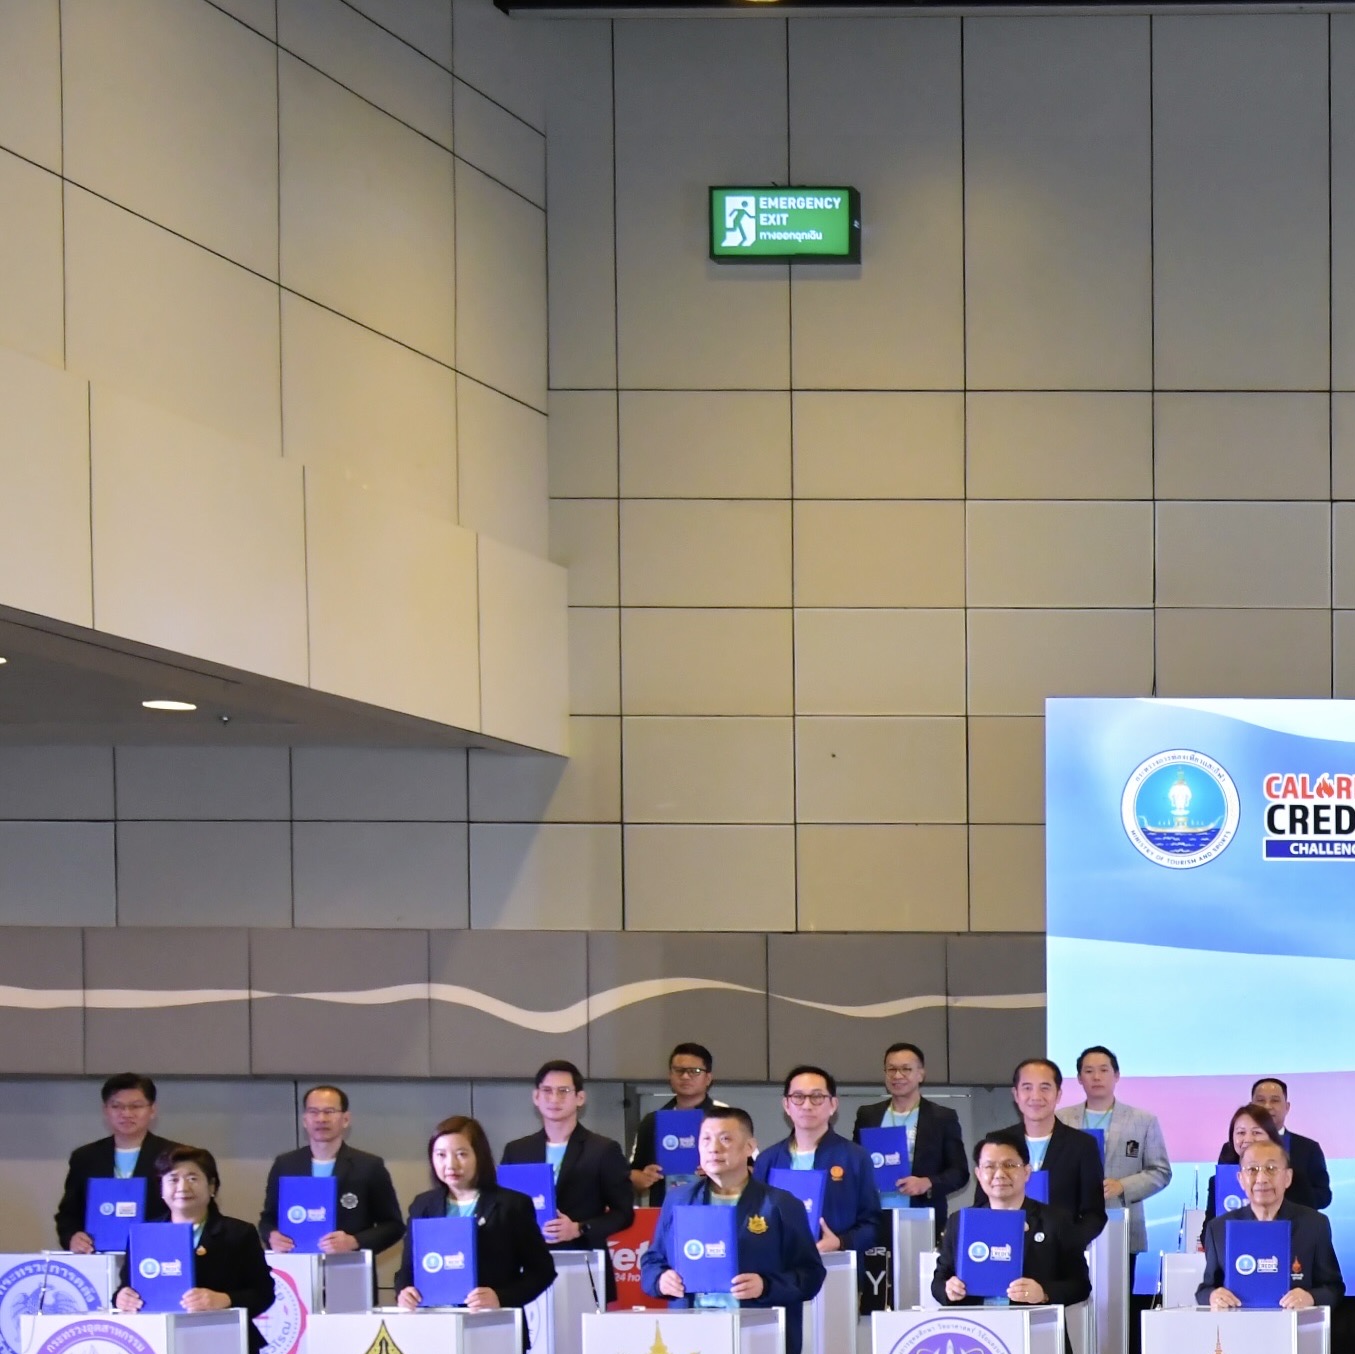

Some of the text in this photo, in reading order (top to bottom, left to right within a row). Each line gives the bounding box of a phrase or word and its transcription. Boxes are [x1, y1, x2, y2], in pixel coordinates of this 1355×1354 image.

[760, 197, 842, 210] EMERGENCY
[760, 213, 789, 226] EXIT
[760, 230, 823, 242] ทางออกฉุกเฉิน
